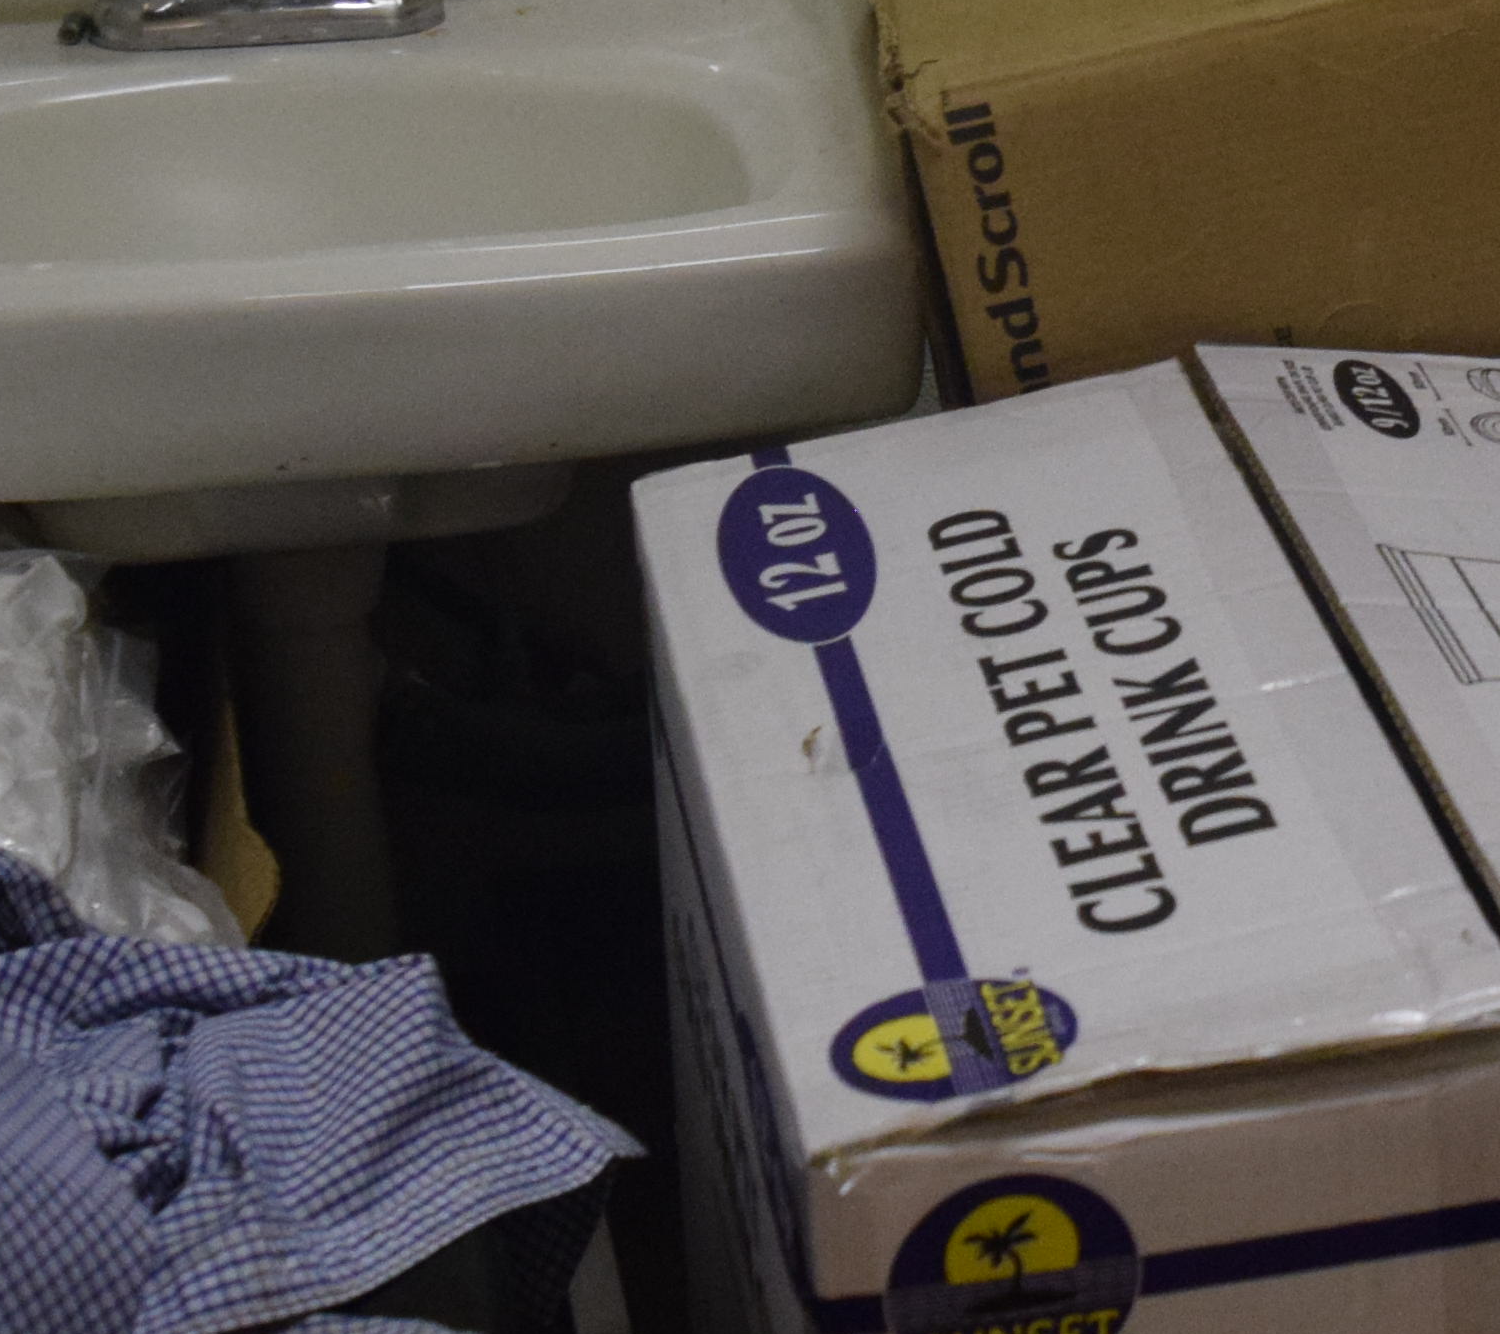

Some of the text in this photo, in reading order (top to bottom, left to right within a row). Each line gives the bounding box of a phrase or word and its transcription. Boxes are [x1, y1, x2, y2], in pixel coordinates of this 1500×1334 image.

[945, 99, 1051, 394] ndScroll
[757, 550, 849, 612] 12
[926, 508, 1178, 934] CLEAR PET COLD
[1052, 527, 1278, 847] DRINK CUPS
[979, 978, 1064, 1077] SUNSET
